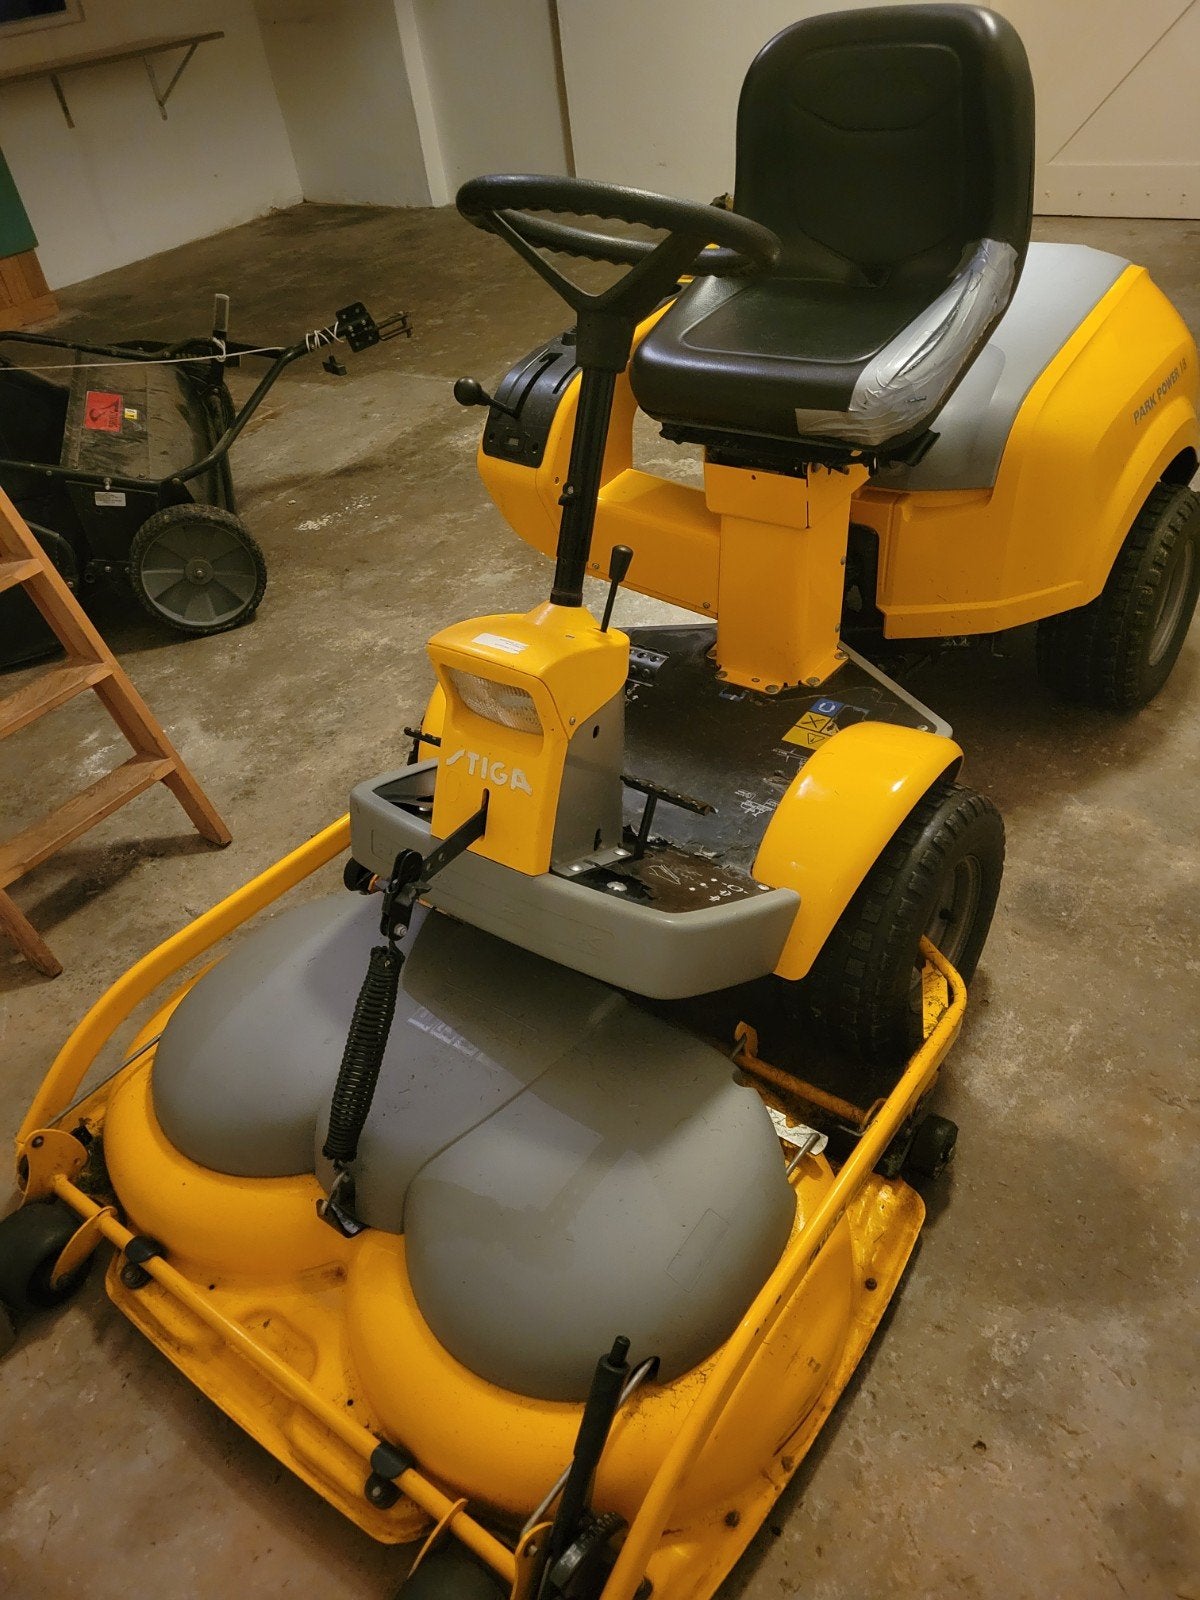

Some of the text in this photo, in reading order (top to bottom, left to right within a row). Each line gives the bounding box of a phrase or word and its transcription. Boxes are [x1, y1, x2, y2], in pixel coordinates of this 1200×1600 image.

[1133, 393, 1157, 426] PARK
[1156, 367, 1180, 401] POWER
[446, 749, 533, 796] STIGA
